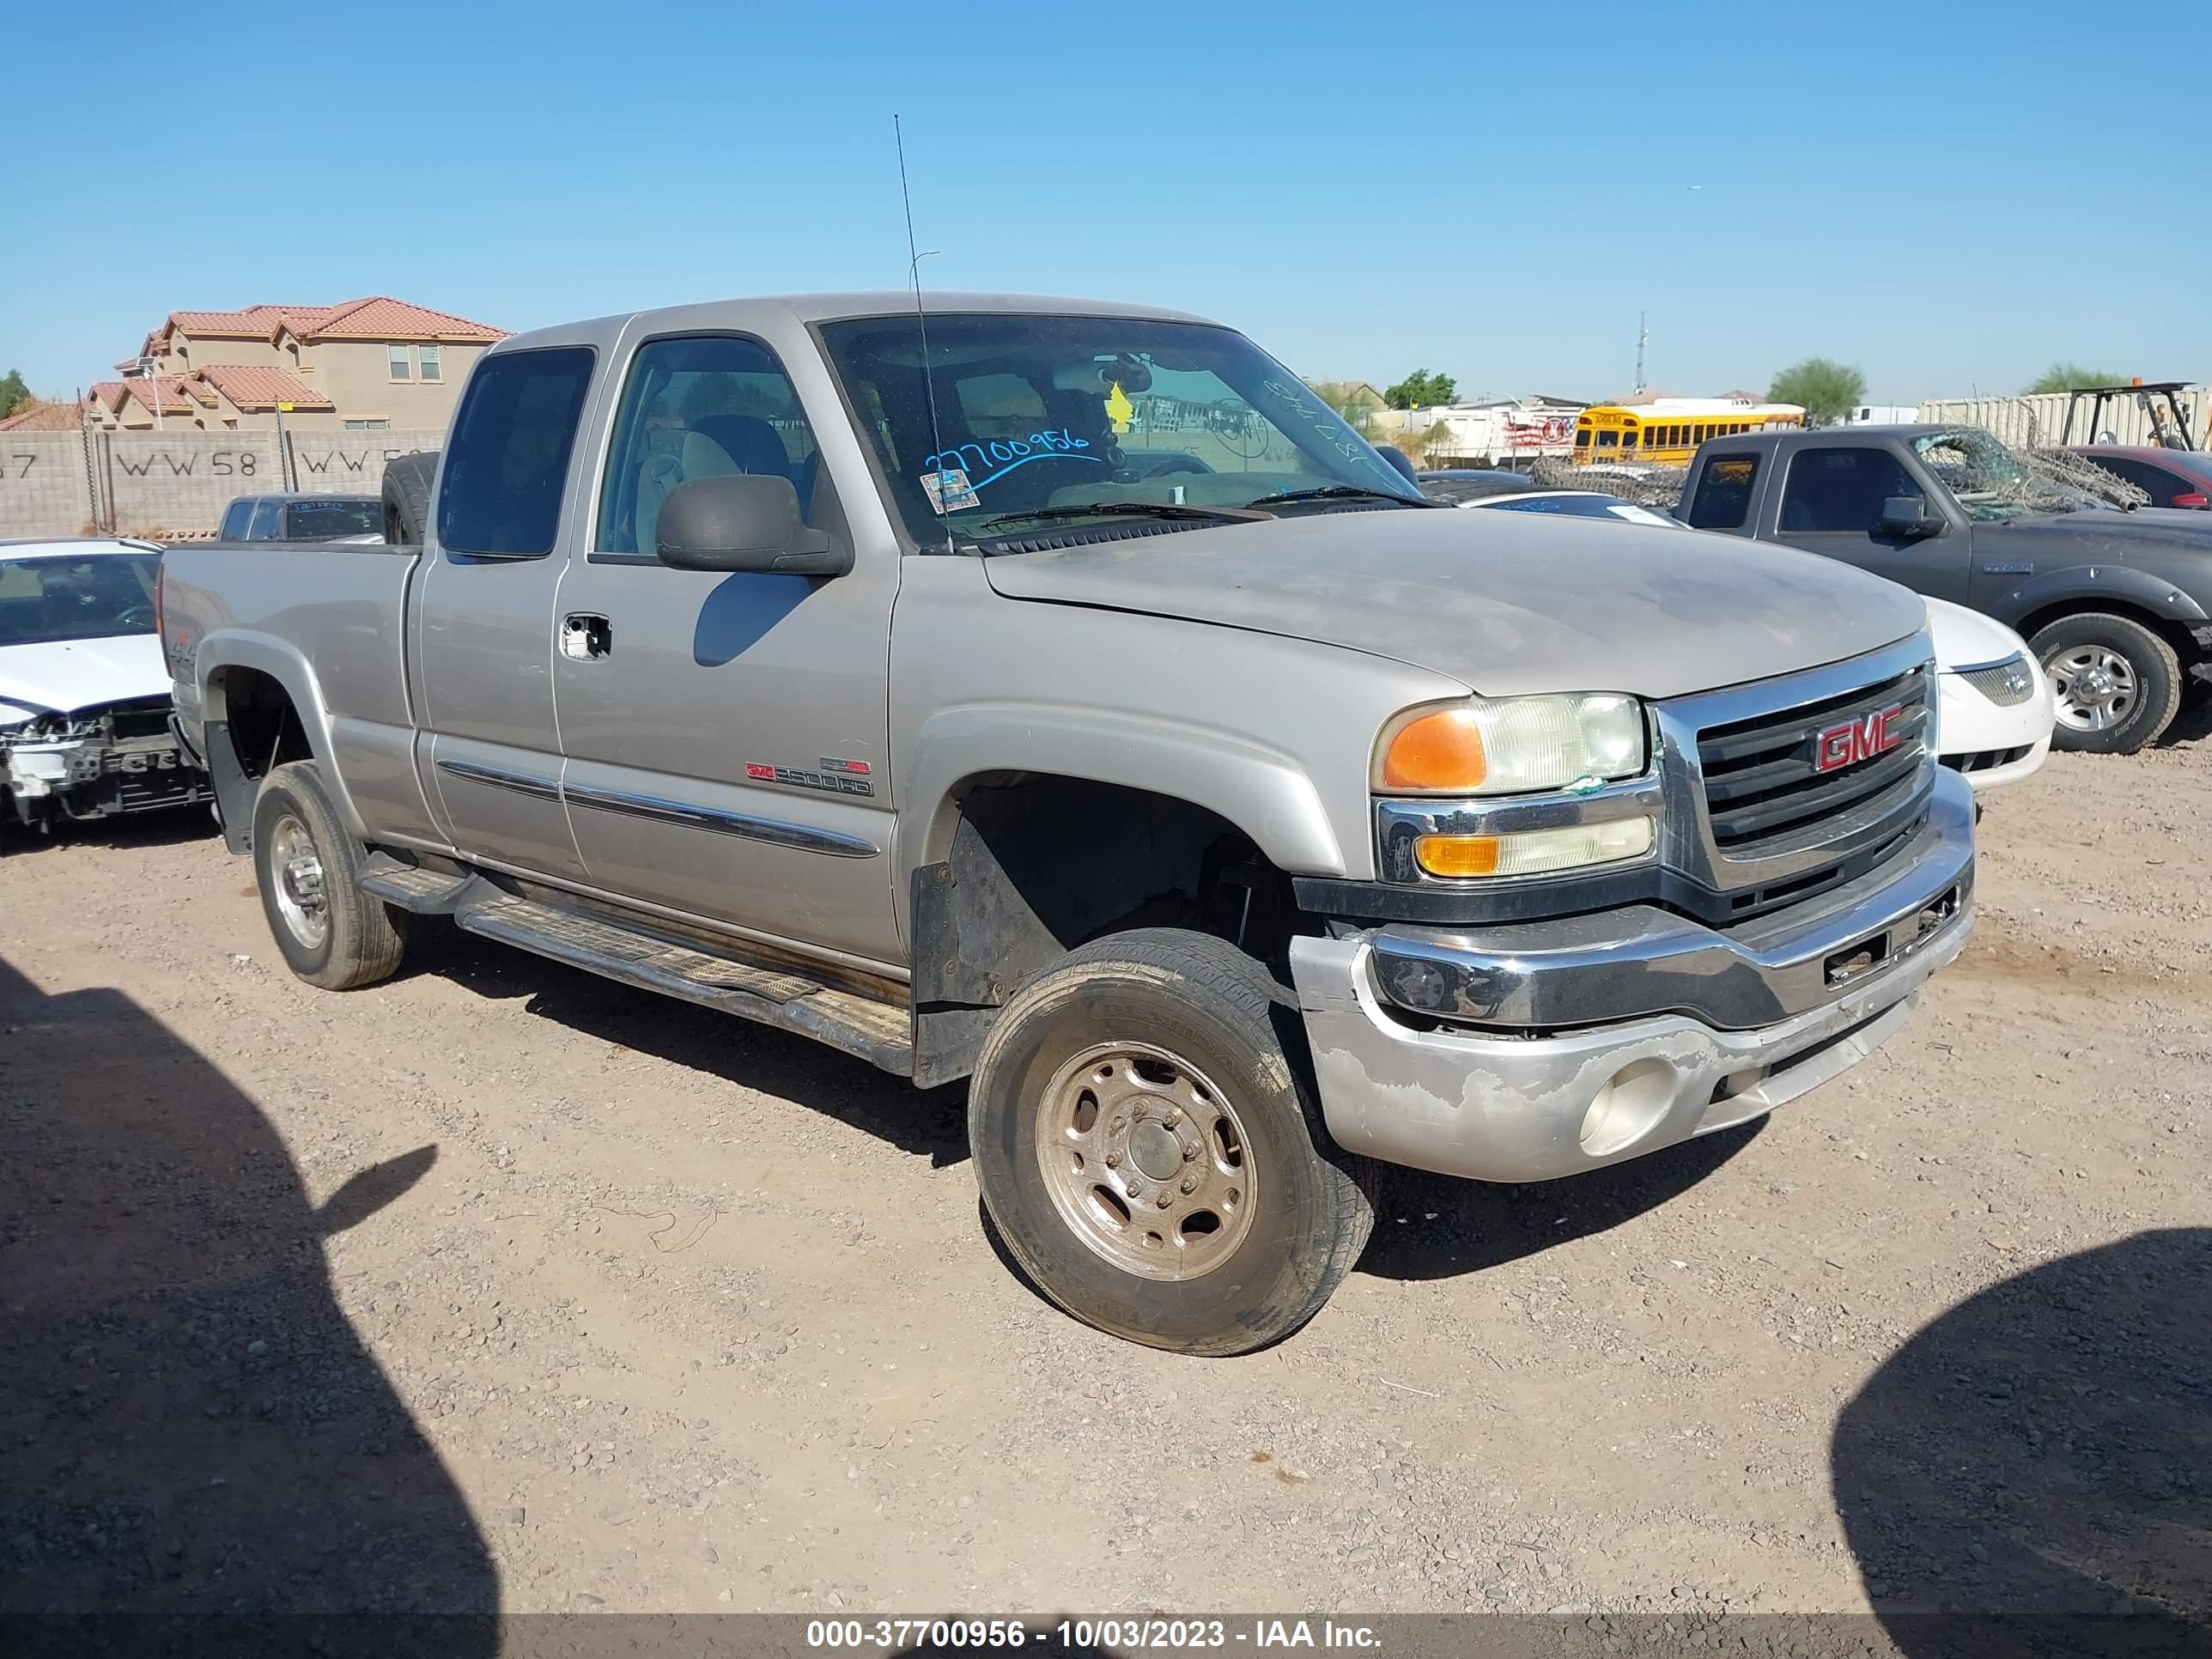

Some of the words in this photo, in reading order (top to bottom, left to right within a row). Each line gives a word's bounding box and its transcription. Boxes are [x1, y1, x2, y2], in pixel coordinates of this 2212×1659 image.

[0, 454, 36, 478] 7
[213, 453, 256, 476] 58
[1815, 702, 1901, 774] GMC
[747, 765, 774, 780] GMC
[775, 767, 871, 795] 2500HD
